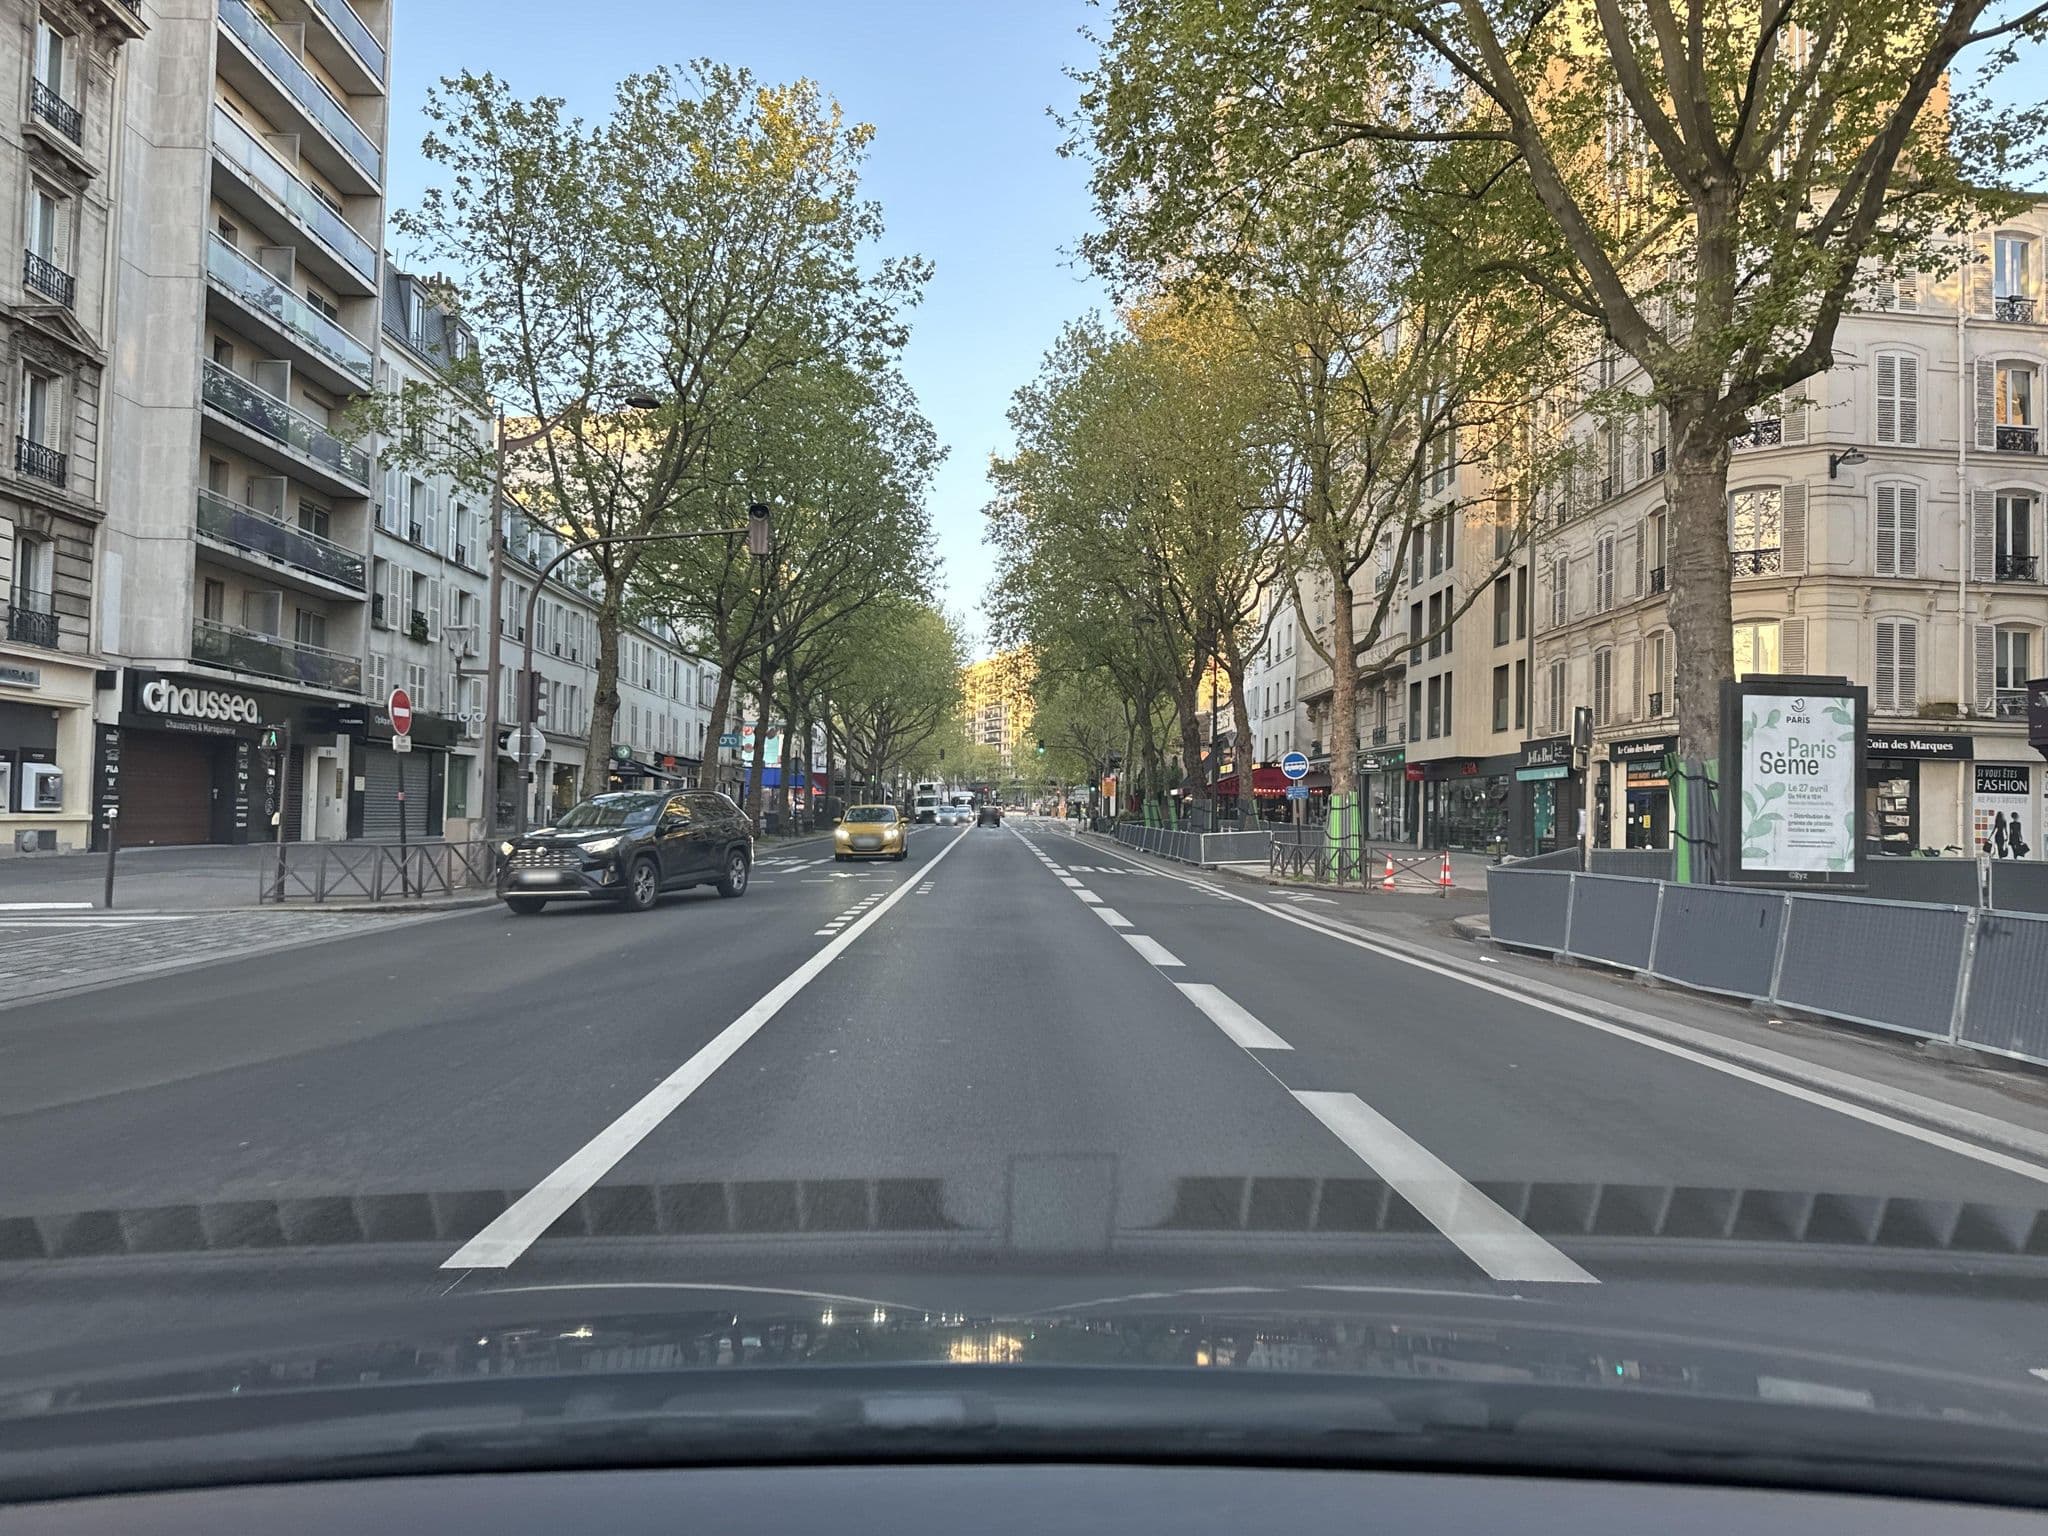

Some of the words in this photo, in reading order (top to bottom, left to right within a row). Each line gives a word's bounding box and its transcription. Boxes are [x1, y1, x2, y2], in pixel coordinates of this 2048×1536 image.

[143, 679, 258, 724] chaussea
[1786, 716, 1811, 724] PARIS
[1788, 737, 1837, 759] Paris
[1891, 739, 1908, 750] des
[1910, 740, 1954, 753] Marques
[1985, 768, 2001, 778] VOUS
[1788, 784, 1798, 792] Le
[1976, 779, 2028, 792] FASHION
